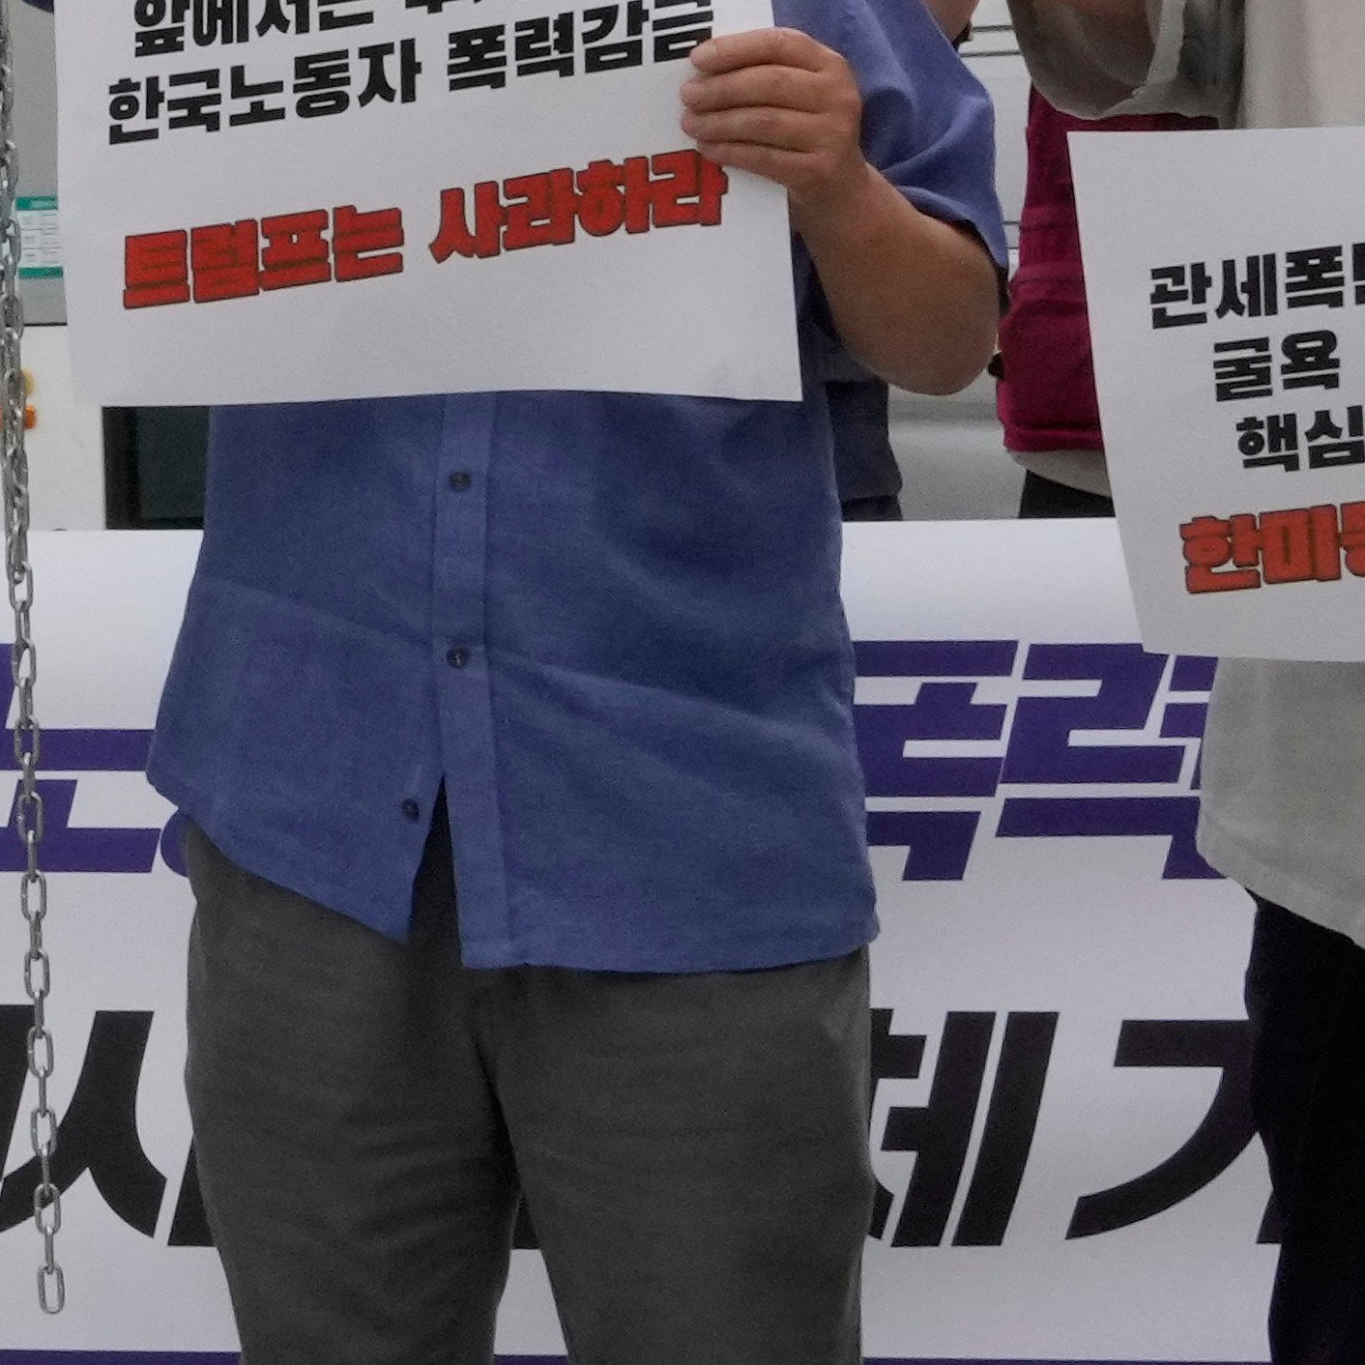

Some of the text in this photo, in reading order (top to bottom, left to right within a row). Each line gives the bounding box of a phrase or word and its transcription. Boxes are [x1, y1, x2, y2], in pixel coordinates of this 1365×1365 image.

[107, 39, 422, 145] 한국노동자
[122, 205, 404, 309] 트럼프는
[429, 149, 728, 264] 사과하라
[1150, 242, 1365, 329] 관세폭
[1213, 329, 1340, 402] 굴욕
[1236, 405, 1365, 472] 핵심
